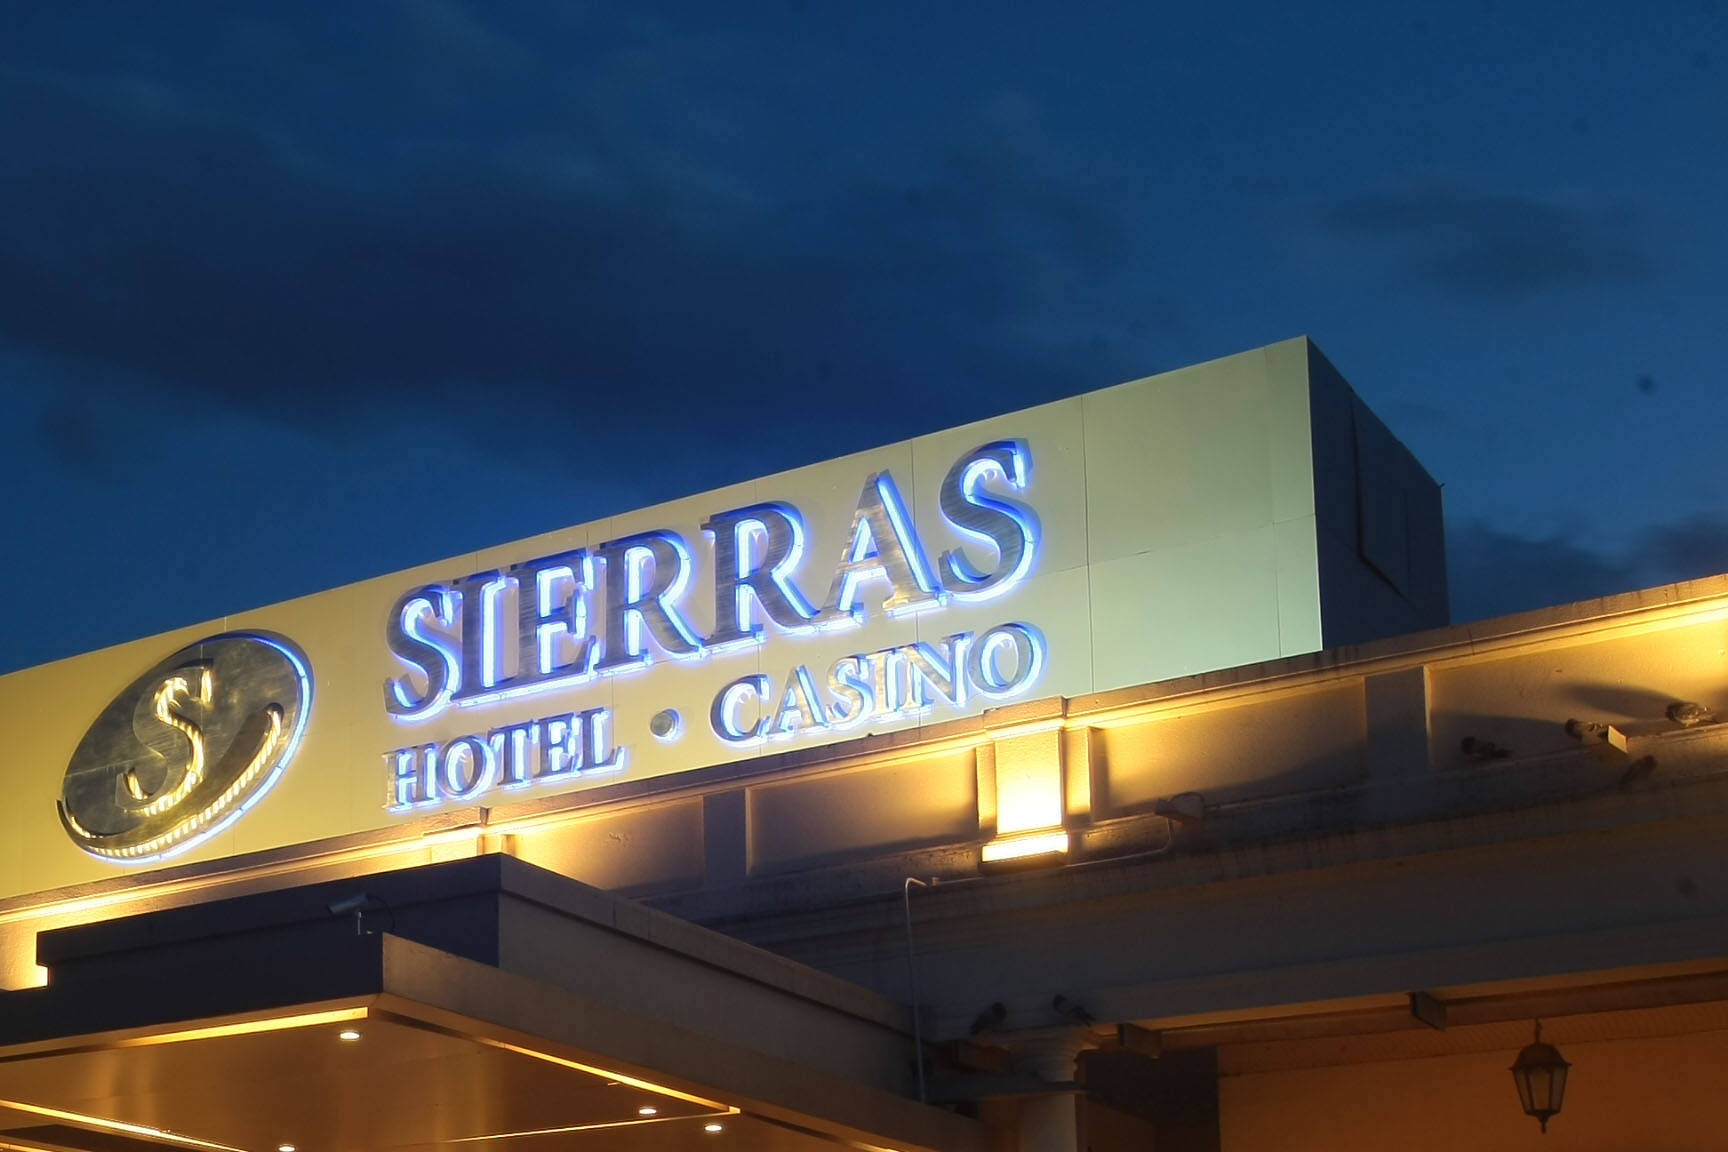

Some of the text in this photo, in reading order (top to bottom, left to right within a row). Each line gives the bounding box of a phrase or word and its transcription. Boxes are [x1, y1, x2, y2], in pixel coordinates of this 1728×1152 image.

[384, 439, 1042, 721] SIERRAS
[120, 657, 215, 818] S
[385, 621, 1046, 812] HOTEL CASINO
